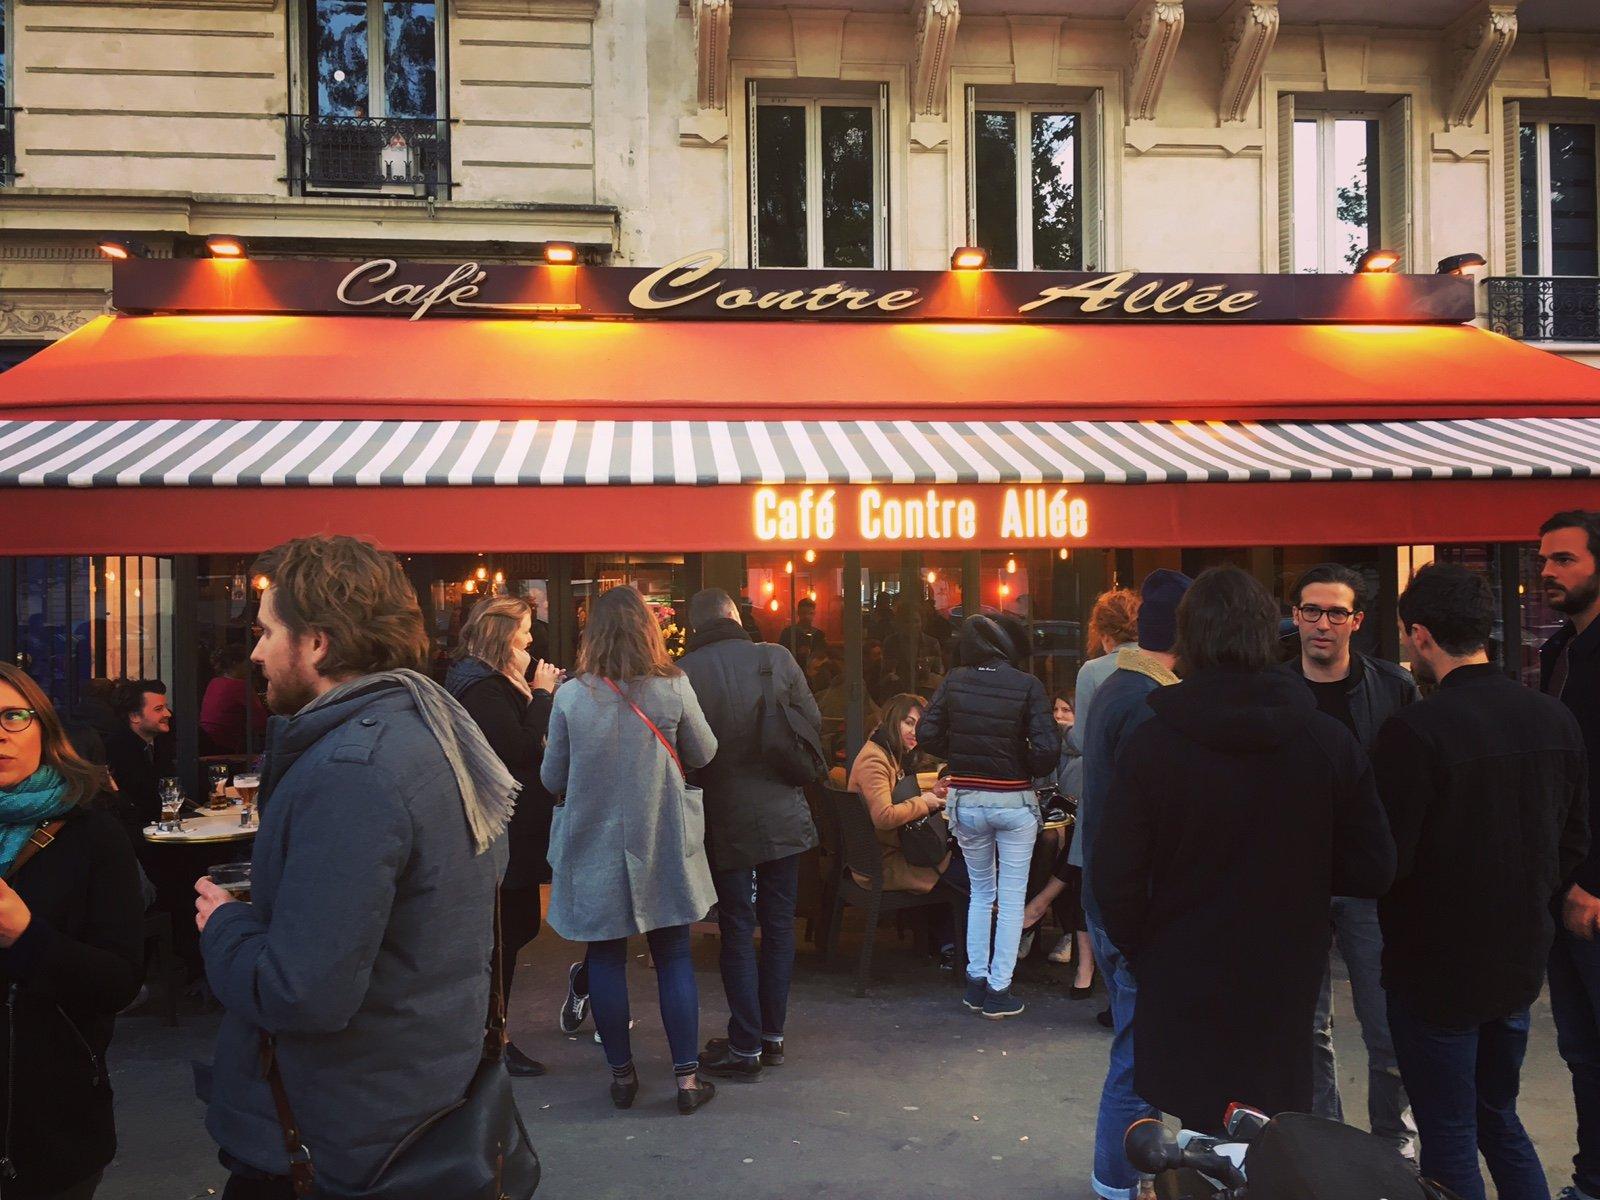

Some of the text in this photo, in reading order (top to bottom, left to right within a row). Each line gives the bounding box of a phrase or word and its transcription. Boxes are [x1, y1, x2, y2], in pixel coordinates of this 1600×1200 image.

[336, 249, 1258, 321] Café Contre Allée
[754, 488, 1089, 540] Café Contre Allée
